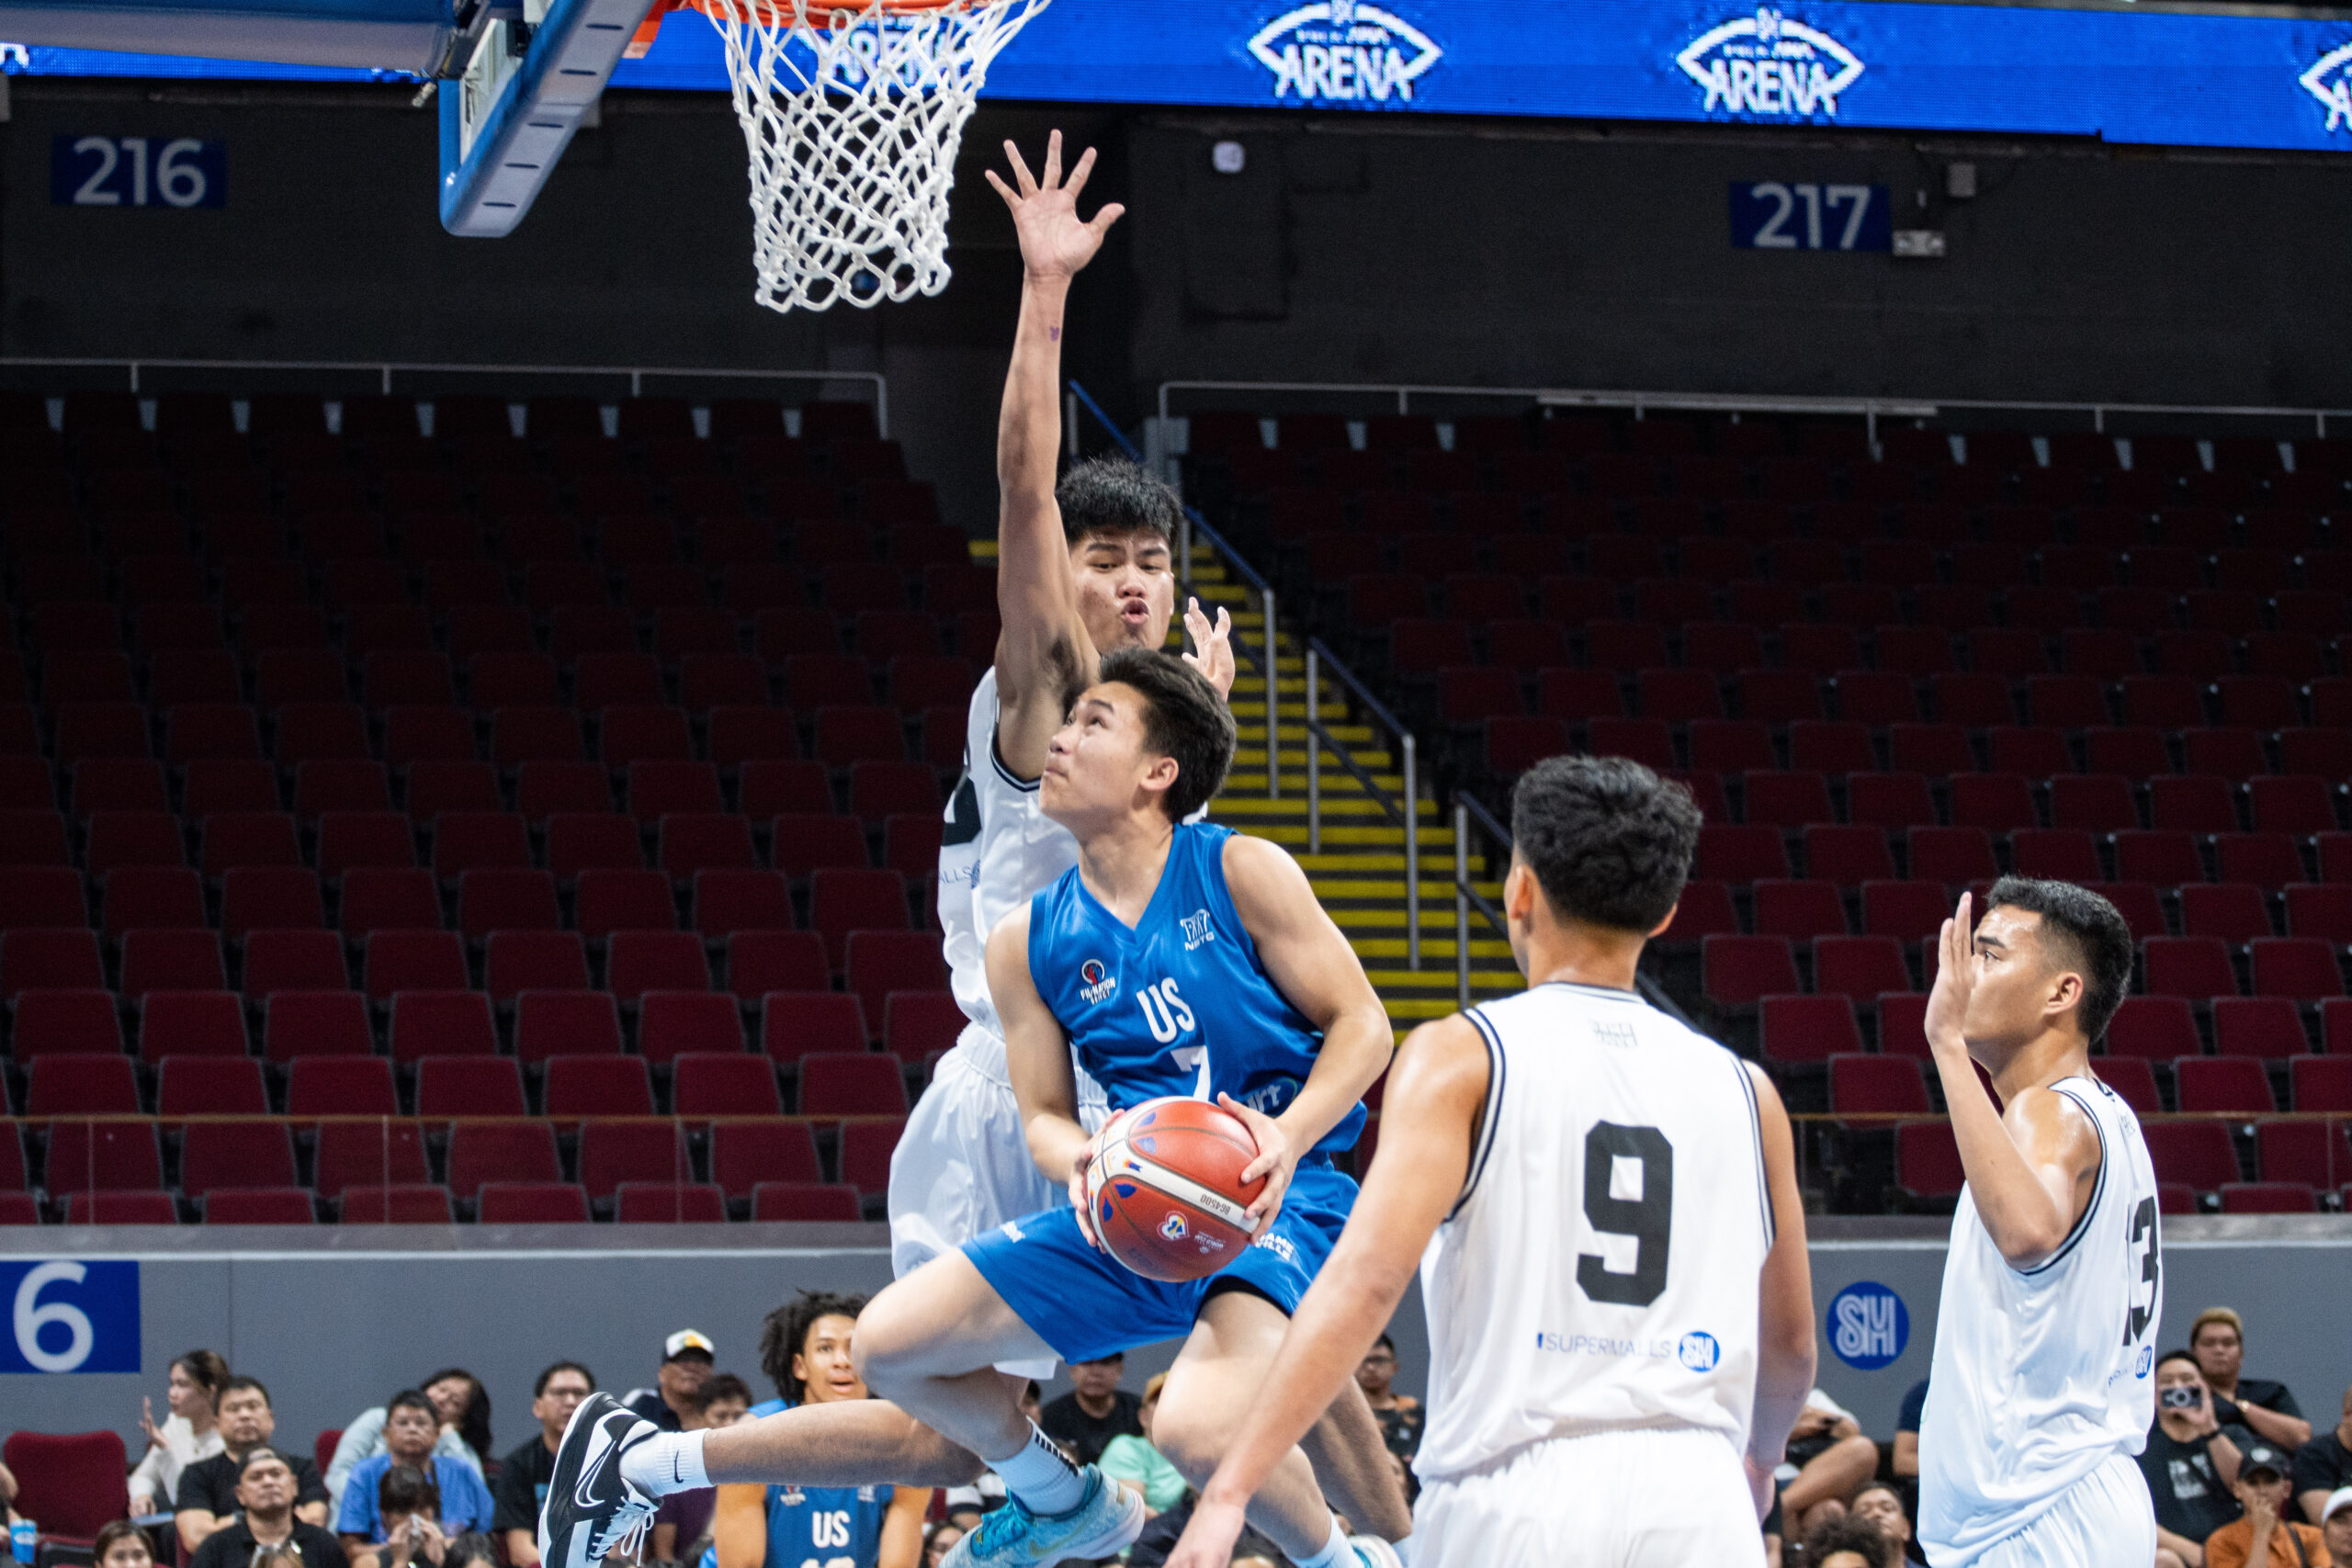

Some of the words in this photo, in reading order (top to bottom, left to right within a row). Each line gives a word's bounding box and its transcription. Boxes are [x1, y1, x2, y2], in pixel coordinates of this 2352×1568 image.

[1275, 44, 1413, 101] ARENA
[1703, 59, 1837, 117] ARENA
[74, 136, 207, 207] 216
[1751, 182, 1871, 250] 217
[1136, 976, 1195, 1043] US
[1170, 1044, 1211, 1102] 7
[1199, 1193, 1231, 1215] BG4500
[1576, 1120, 1673, 1307] 9
[13, 1260, 94, 1372] 6
[1545, 1332, 1671, 1359] SUPERMALS
[1836, 1294, 1896, 1358] SM
[812, 1509, 851, 1549] US
